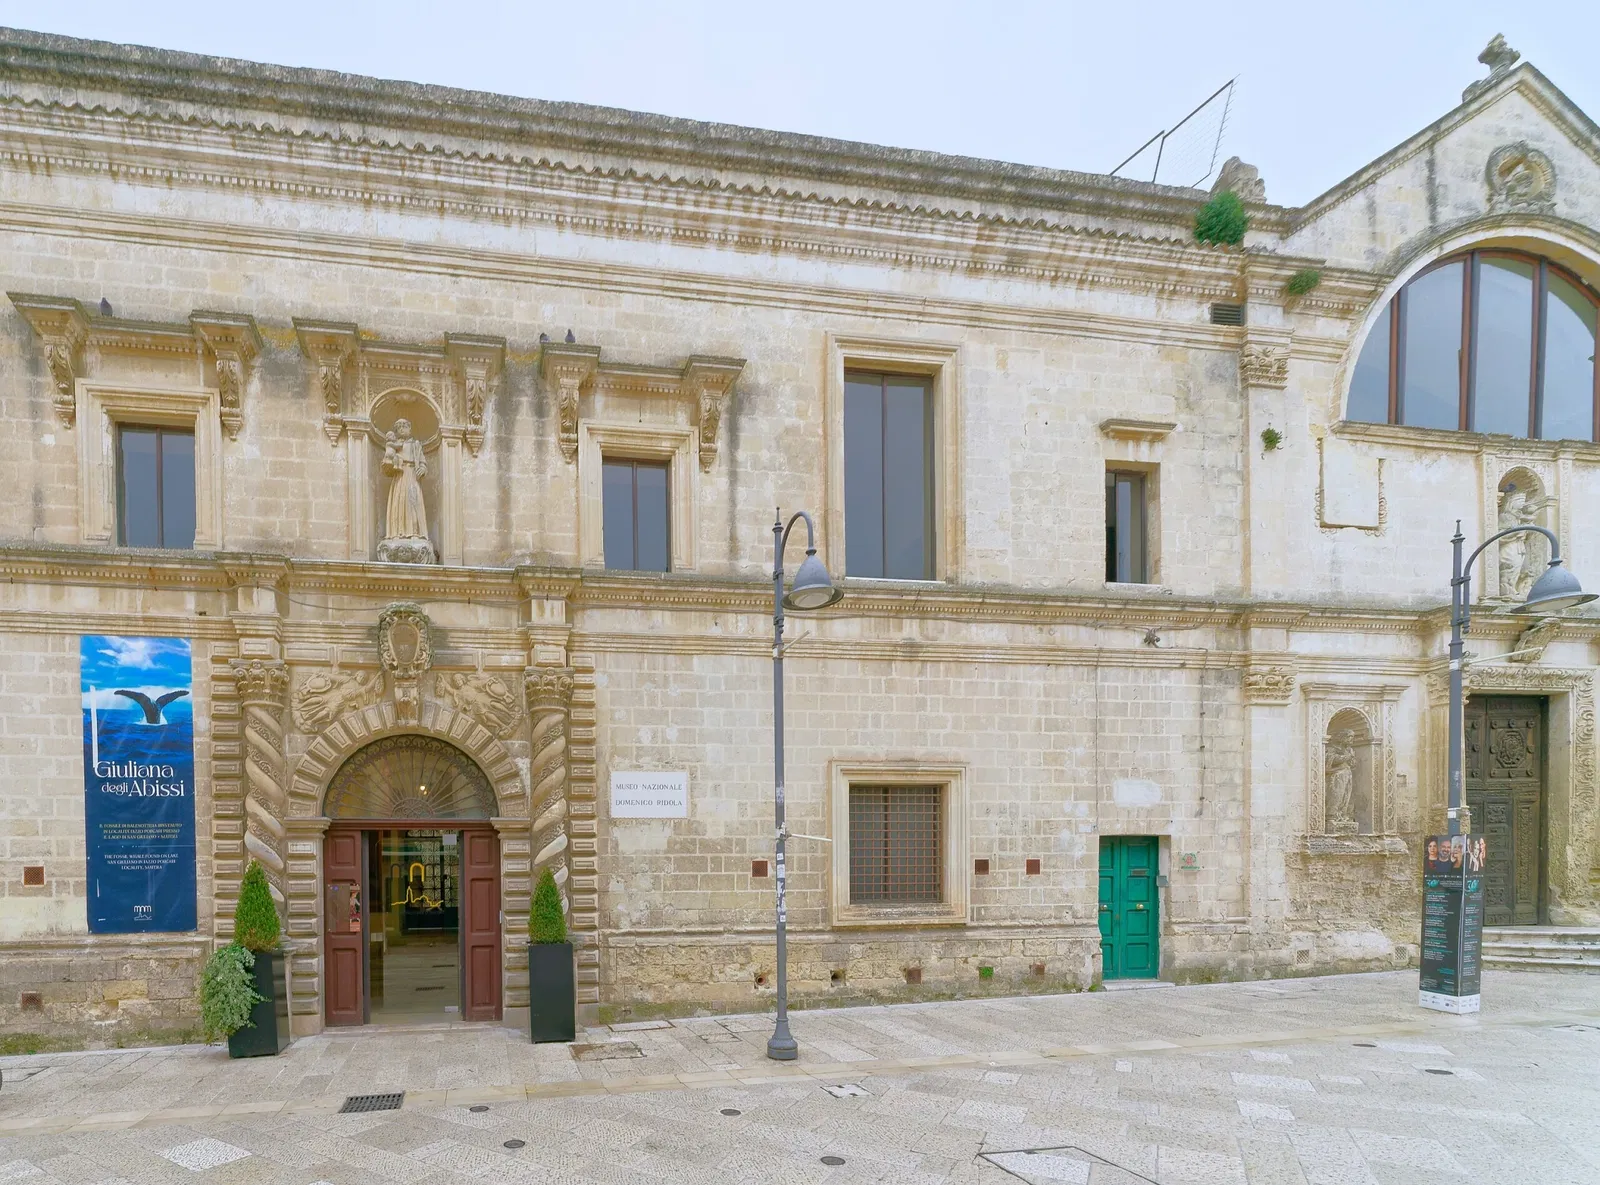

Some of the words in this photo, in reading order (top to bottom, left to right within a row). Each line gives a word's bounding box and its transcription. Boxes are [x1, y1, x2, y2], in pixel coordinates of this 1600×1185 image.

[94, 760, 174, 778] Giuliana
[101, 782, 128, 796] degli
[128, 780, 185, 797] Abissi
